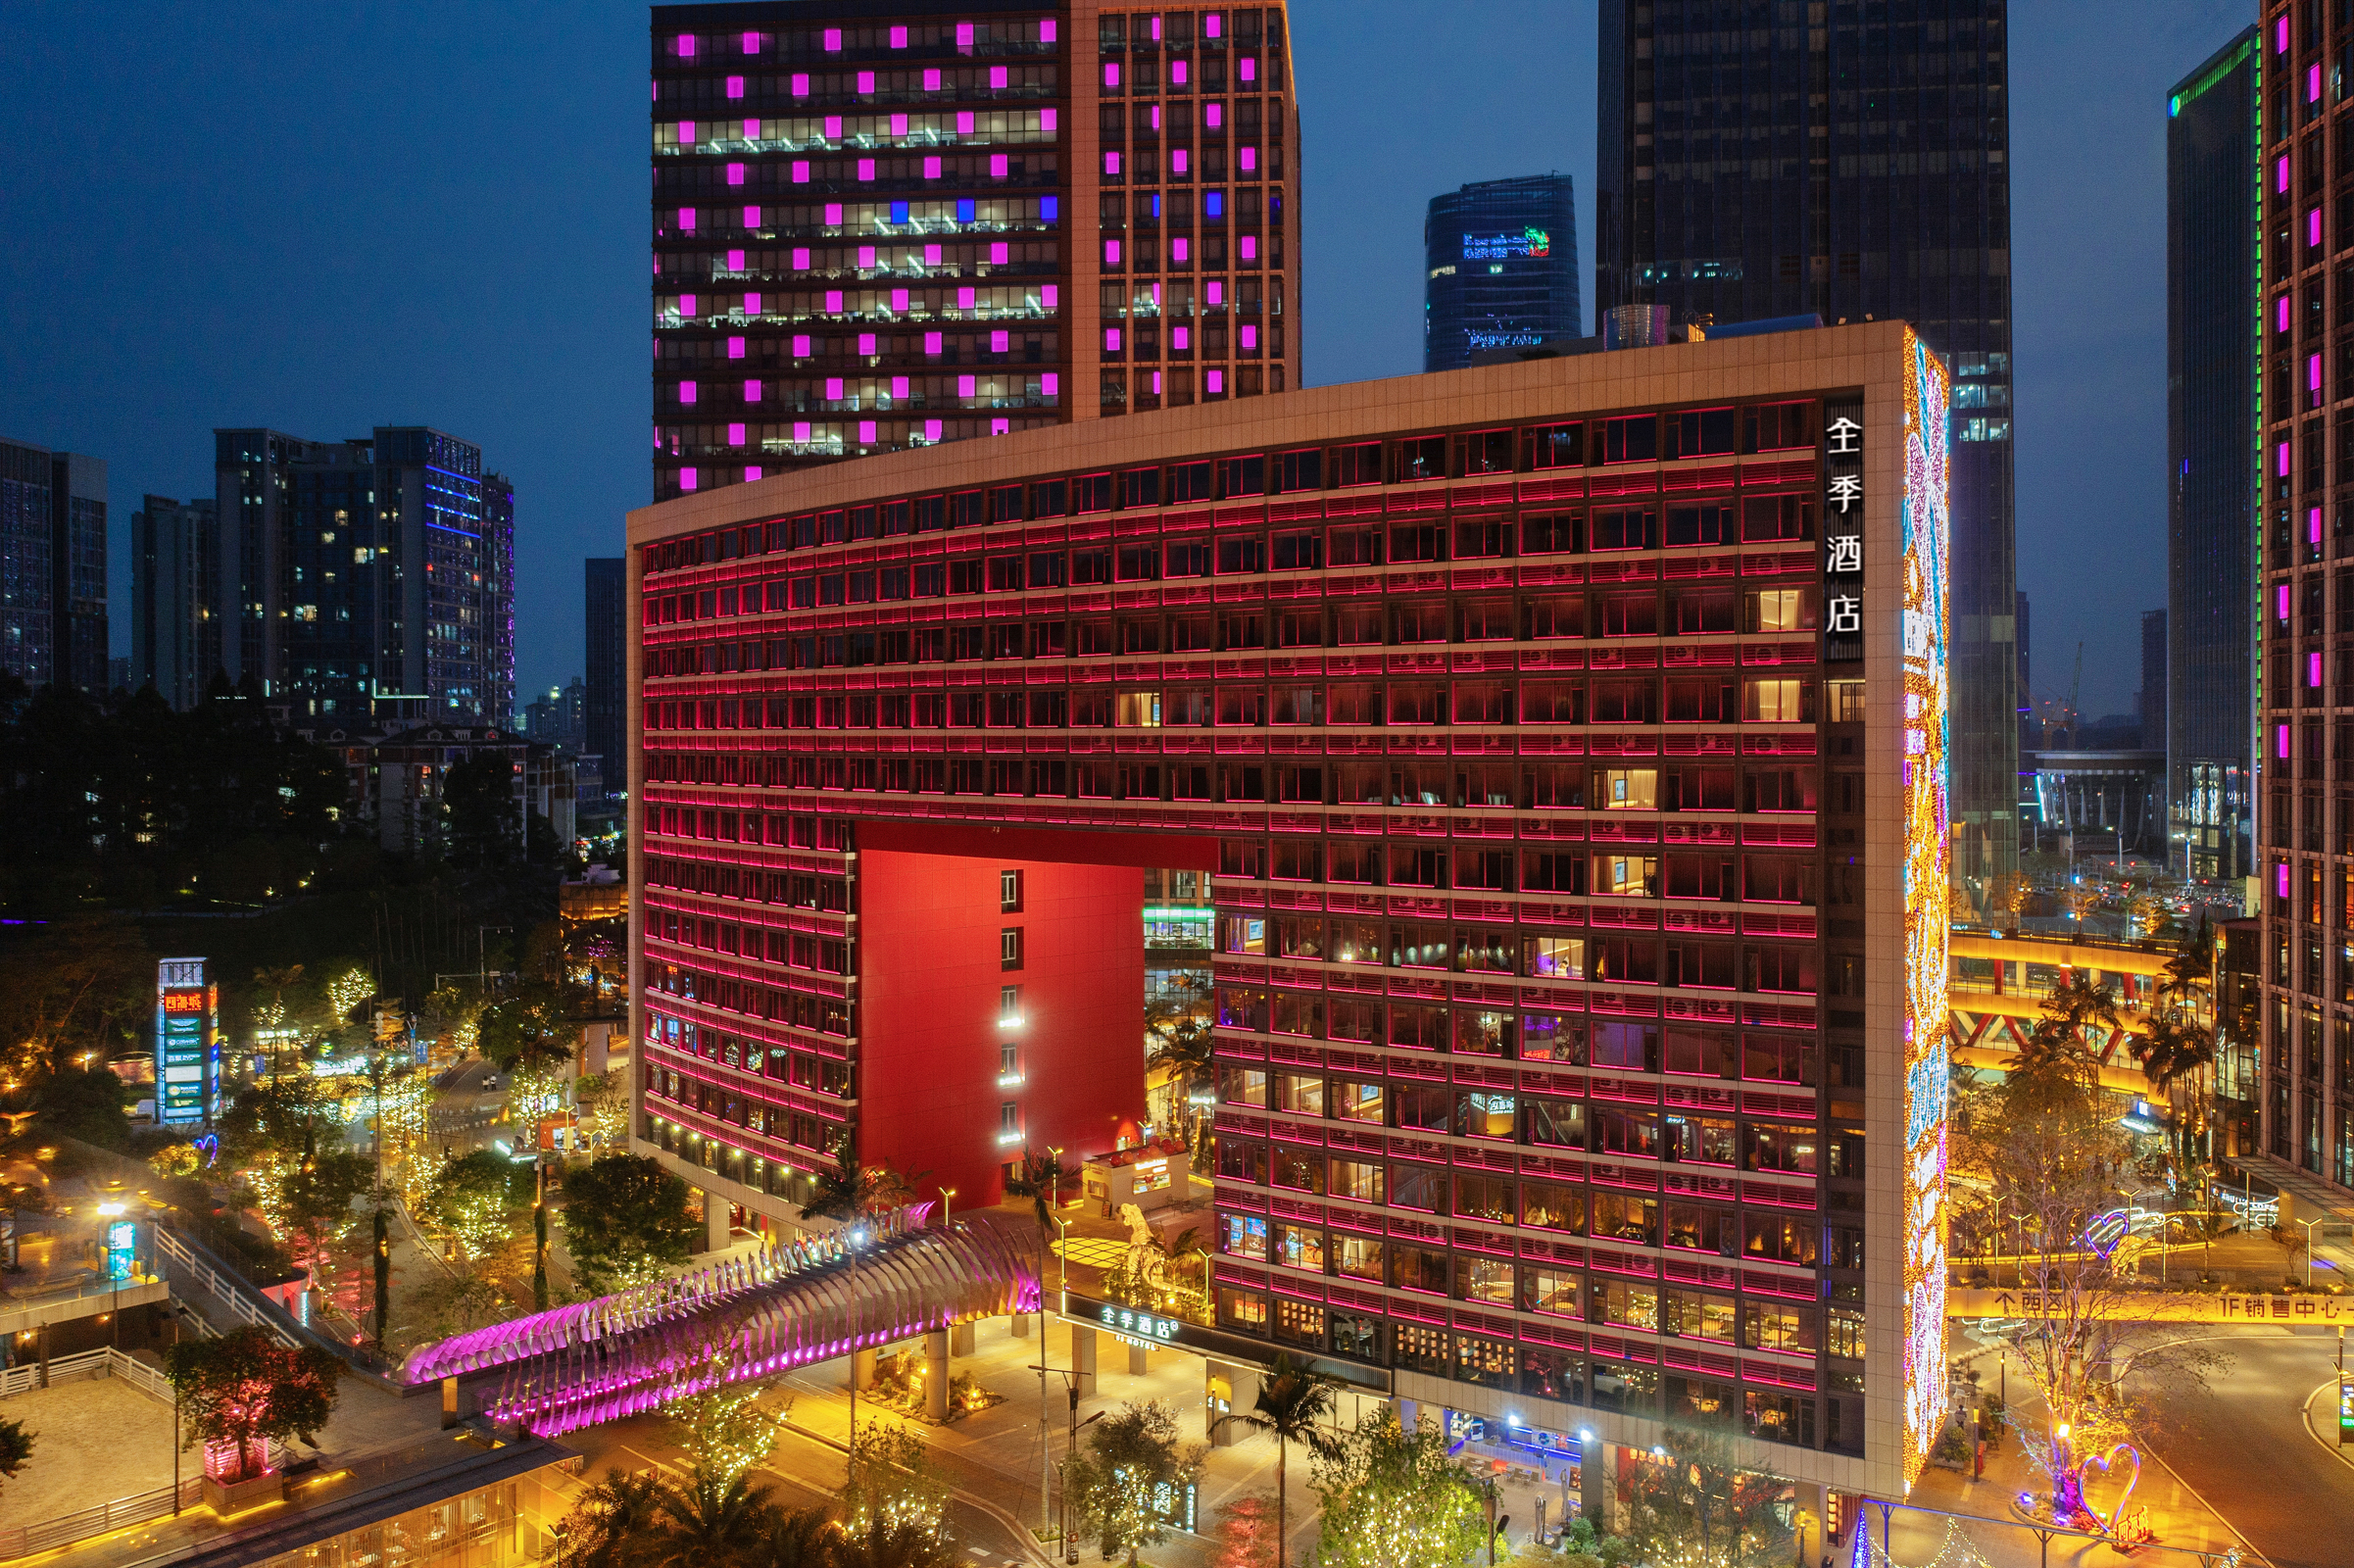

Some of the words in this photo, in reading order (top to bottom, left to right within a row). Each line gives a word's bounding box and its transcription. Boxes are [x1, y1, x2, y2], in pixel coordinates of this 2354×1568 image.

[1826, 416, 1862, 633] 全季酒店
[1102, 1306, 1170, 1339] 全季酒店
[1126, 1338, 1156, 1351] HOTEL
